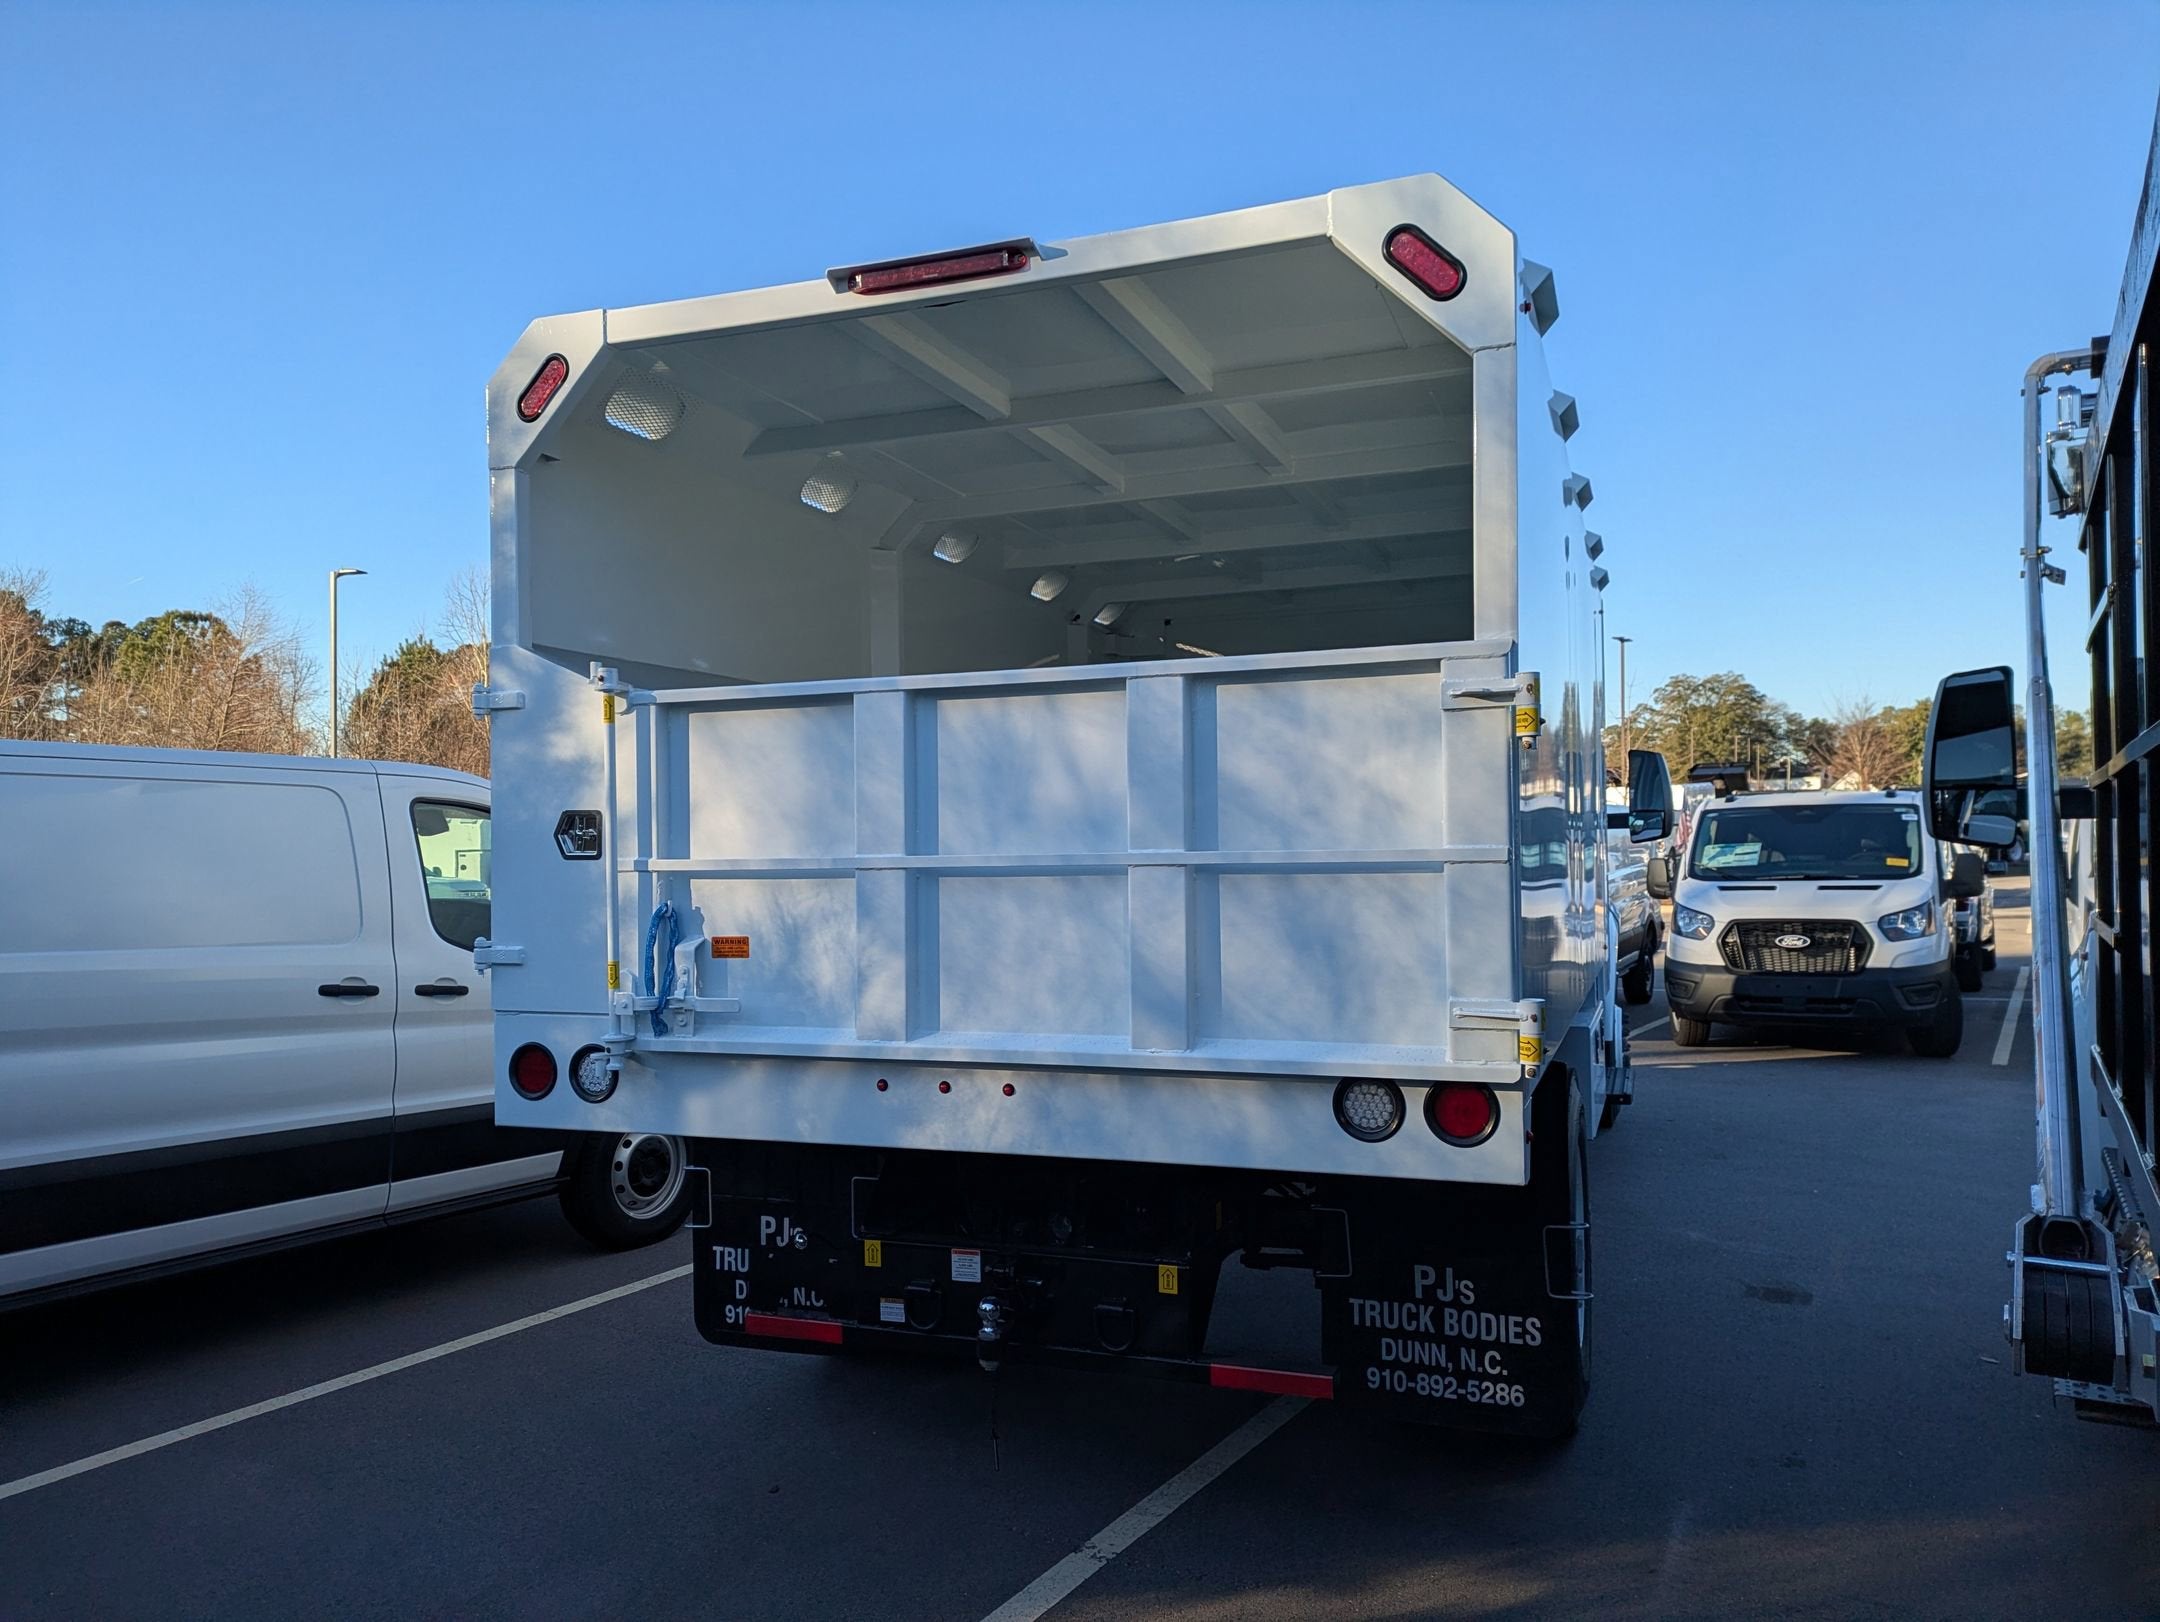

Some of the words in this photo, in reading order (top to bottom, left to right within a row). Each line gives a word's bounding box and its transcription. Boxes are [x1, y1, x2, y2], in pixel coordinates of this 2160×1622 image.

[711, 1245, 750, 1273] TRU
[1348, 1297, 1435, 1334] TRUCK
[1444, 1307, 1542, 1347] BODIES
[1381, 1337, 1453, 1374] DUNN,
[1460, 1346, 1508, 1376] N.C.
[1366, 1366, 1526, 1408] 910-892-5286
